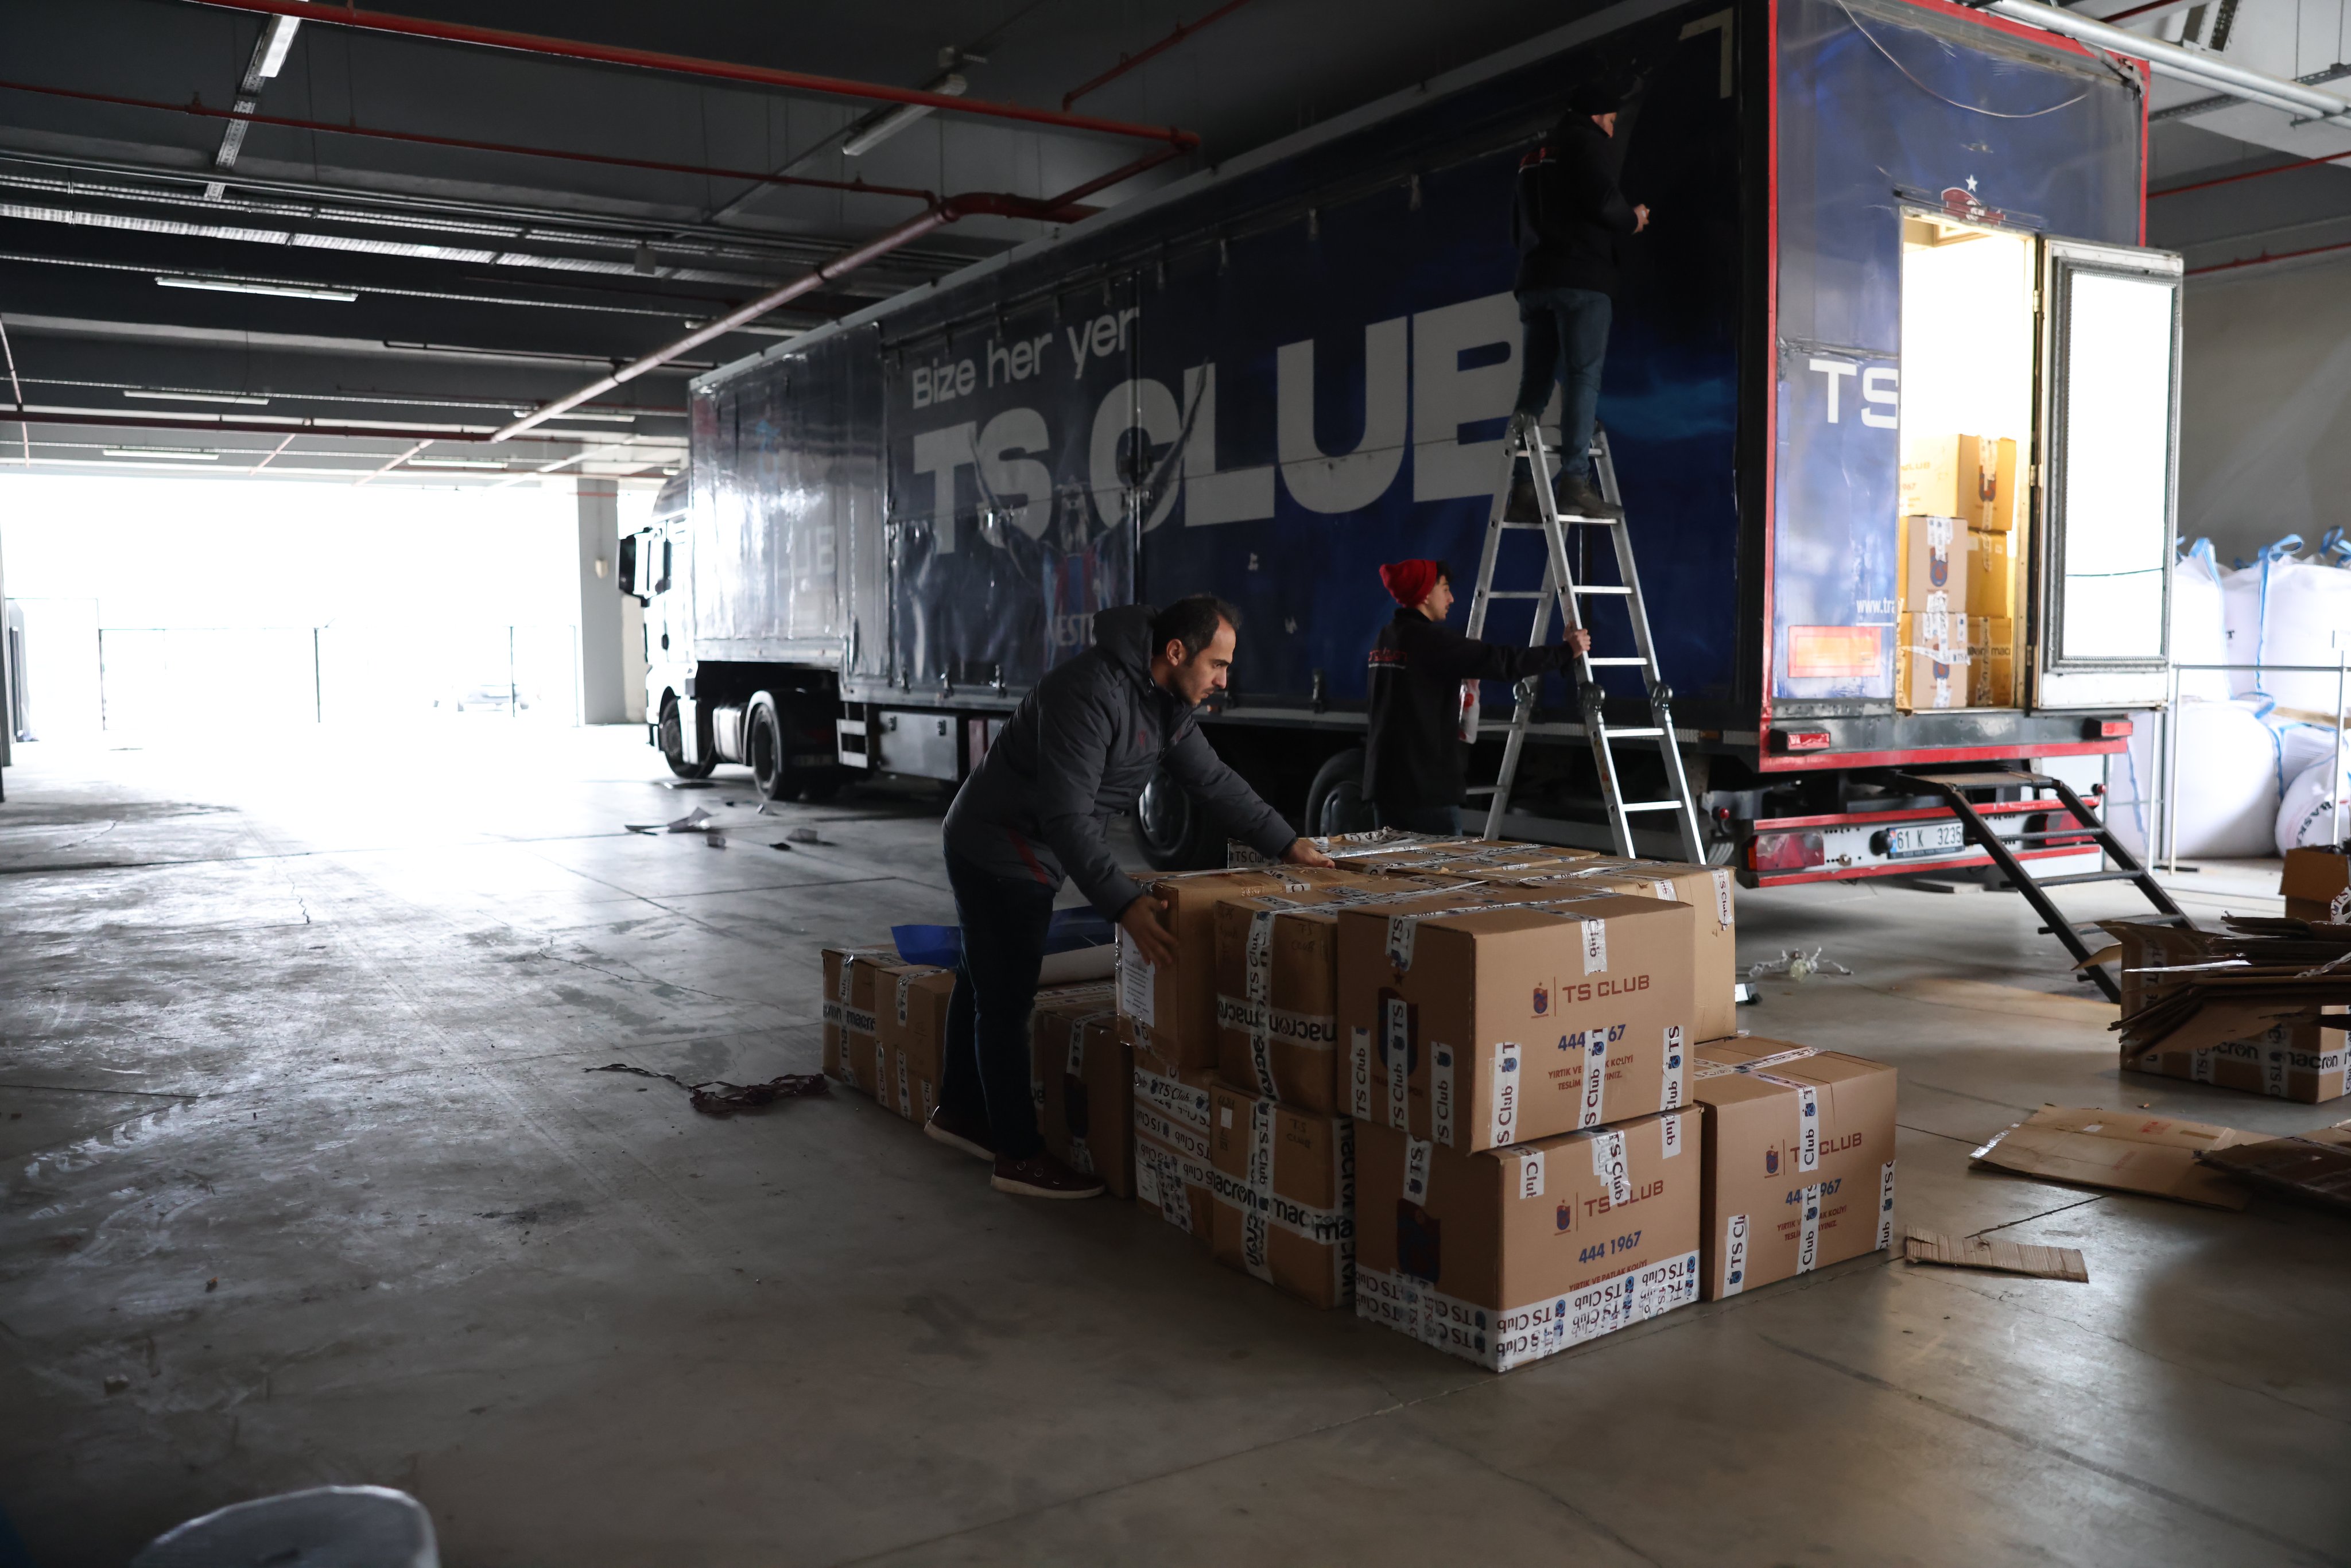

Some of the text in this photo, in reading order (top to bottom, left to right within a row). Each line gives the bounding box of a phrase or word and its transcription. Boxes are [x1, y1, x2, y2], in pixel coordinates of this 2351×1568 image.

[913, 306, 1140, 410] Bize her yer
[1809, 358, 1899, 430] TS
[914, 407, 1053, 556] TS
[1897, 825, 1962, 849] 61 K 3235
[1236, 851, 1264, 862] TS Clu
[1718, 871, 1726, 889] TS
[1391, 918, 1403, 945] TS
[1249, 932, 1259, 996] TS Club
[1562, 975, 1650, 1003] TS CLUB
[1392, 1004, 1403, 1031] TS
[1558, 1024, 1626, 1051] 444 67
[1668, 1025, 1679, 1053] TS
[1356, 1047, 1367, 1114] TS Club
[1548, 1068, 1571, 1080] YIRTIK
[1573, 1065, 1582, 1076] VE
[1159, 1082, 1170, 1097] TS
[1393, 1063, 1405, 1130] TS Club
[1437, 1080, 1448, 1120] Club
[1586, 1069, 1600, 1108] Club
[1498, 1085, 1513, 1126] Club
[1141, 1144, 1157, 1162] Club
[1175, 1131, 1212, 1161] Club TS
[1259, 1119, 1268, 1185] TS Club
[1804, 1128, 1815, 1166] Club
[1819, 1132, 1862, 1156] CLUB
[1183, 1163, 1204, 1181] Club
[1410, 1147, 1422, 1173] TS
[1608, 1134, 1624, 1201] TS Club
[1785, 1178, 1842, 1205] 44 967
[1884, 1172, 1894, 1197] TS
[1584, 1195, 1611, 1217] TS
[1777, 1219, 1796, 1231] YIRTIK
[1578, 1230, 1642, 1263] 444 1967
[1731, 1242, 1743, 1268] TS
[1802, 1230, 1814, 1266] Club
[1592, 1276, 1601, 1284] VE
[1601, 1267, 1627, 1282] PATLAK
[1642, 1262, 1685, 1287] Club TS
[1380, 1281, 1400, 1301] TS
[1574, 1283, 1623, 1310] Club TS
[1381, 1302, 1400, 1322] TS
[1451, 1306, 1472, 1326] TS
[1496, 1307, 1552, 1334] Club TS
[1451, 1328, 1472, 1349] TS
[1496, 1336, 1528, 1357] Club
